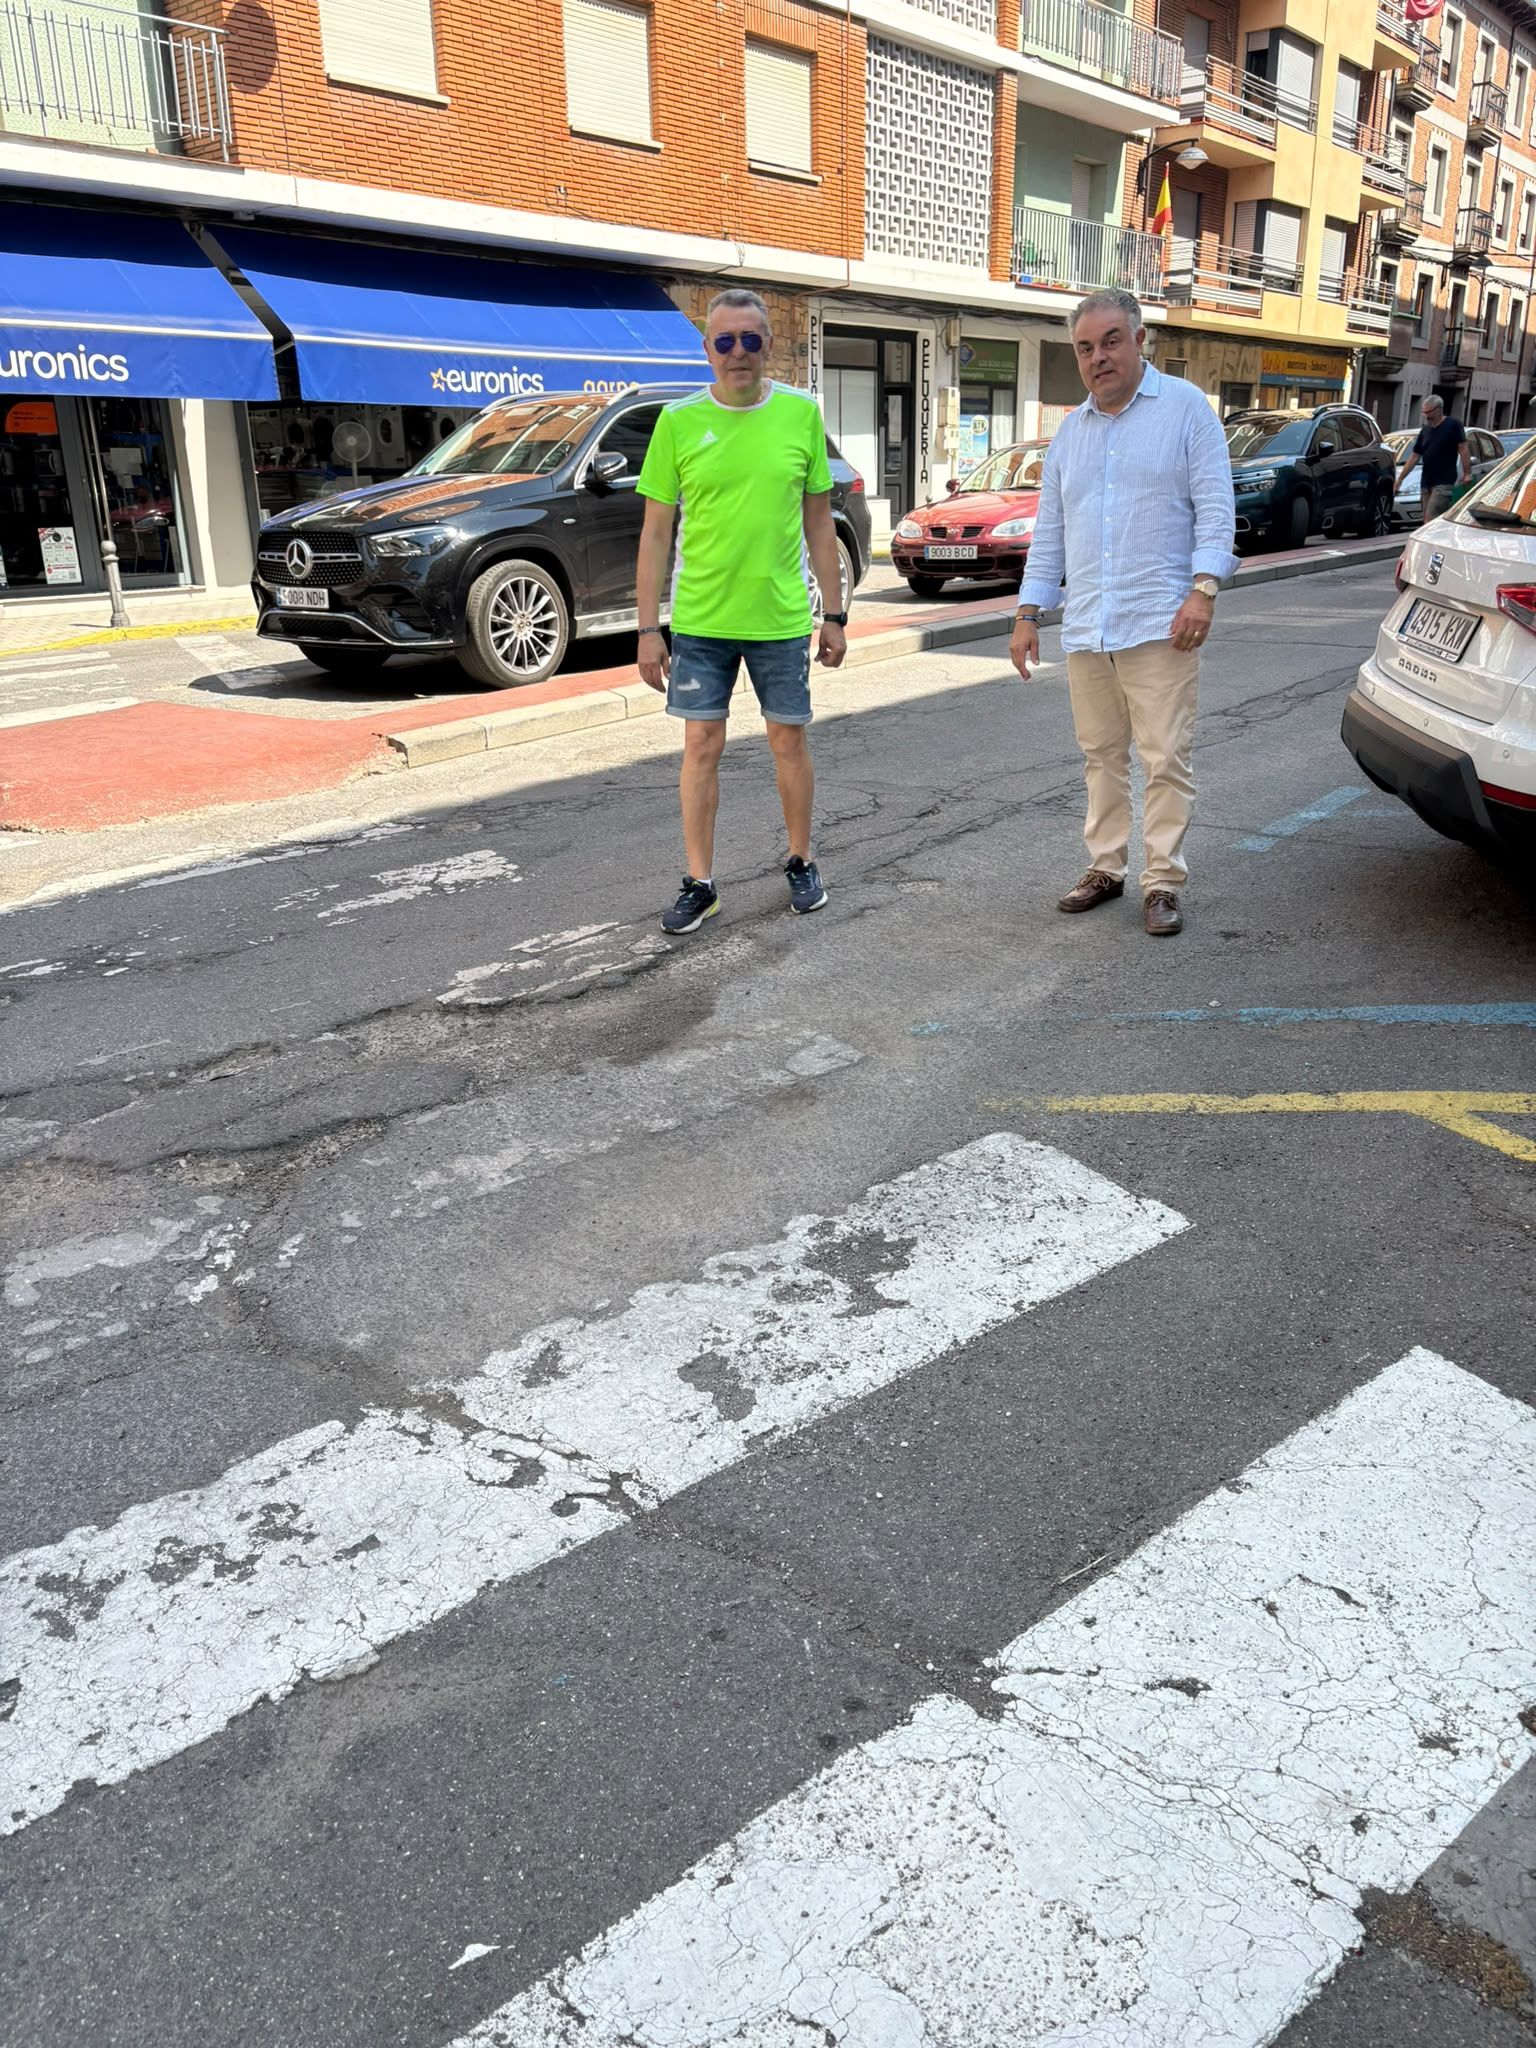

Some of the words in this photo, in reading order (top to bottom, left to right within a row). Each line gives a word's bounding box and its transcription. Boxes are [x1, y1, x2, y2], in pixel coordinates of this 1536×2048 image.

[0, 343, 130, 382] uronics
[446, 366, 544, 395] euronics
[920, 338, 930, 484] PELUQUERIA
[930, 547, 952, 558] 9003
[954, 547, 974, 558] BCD
[306, 590, 325, 606] NDH
[1410, 604, 1446, 640] 4915
